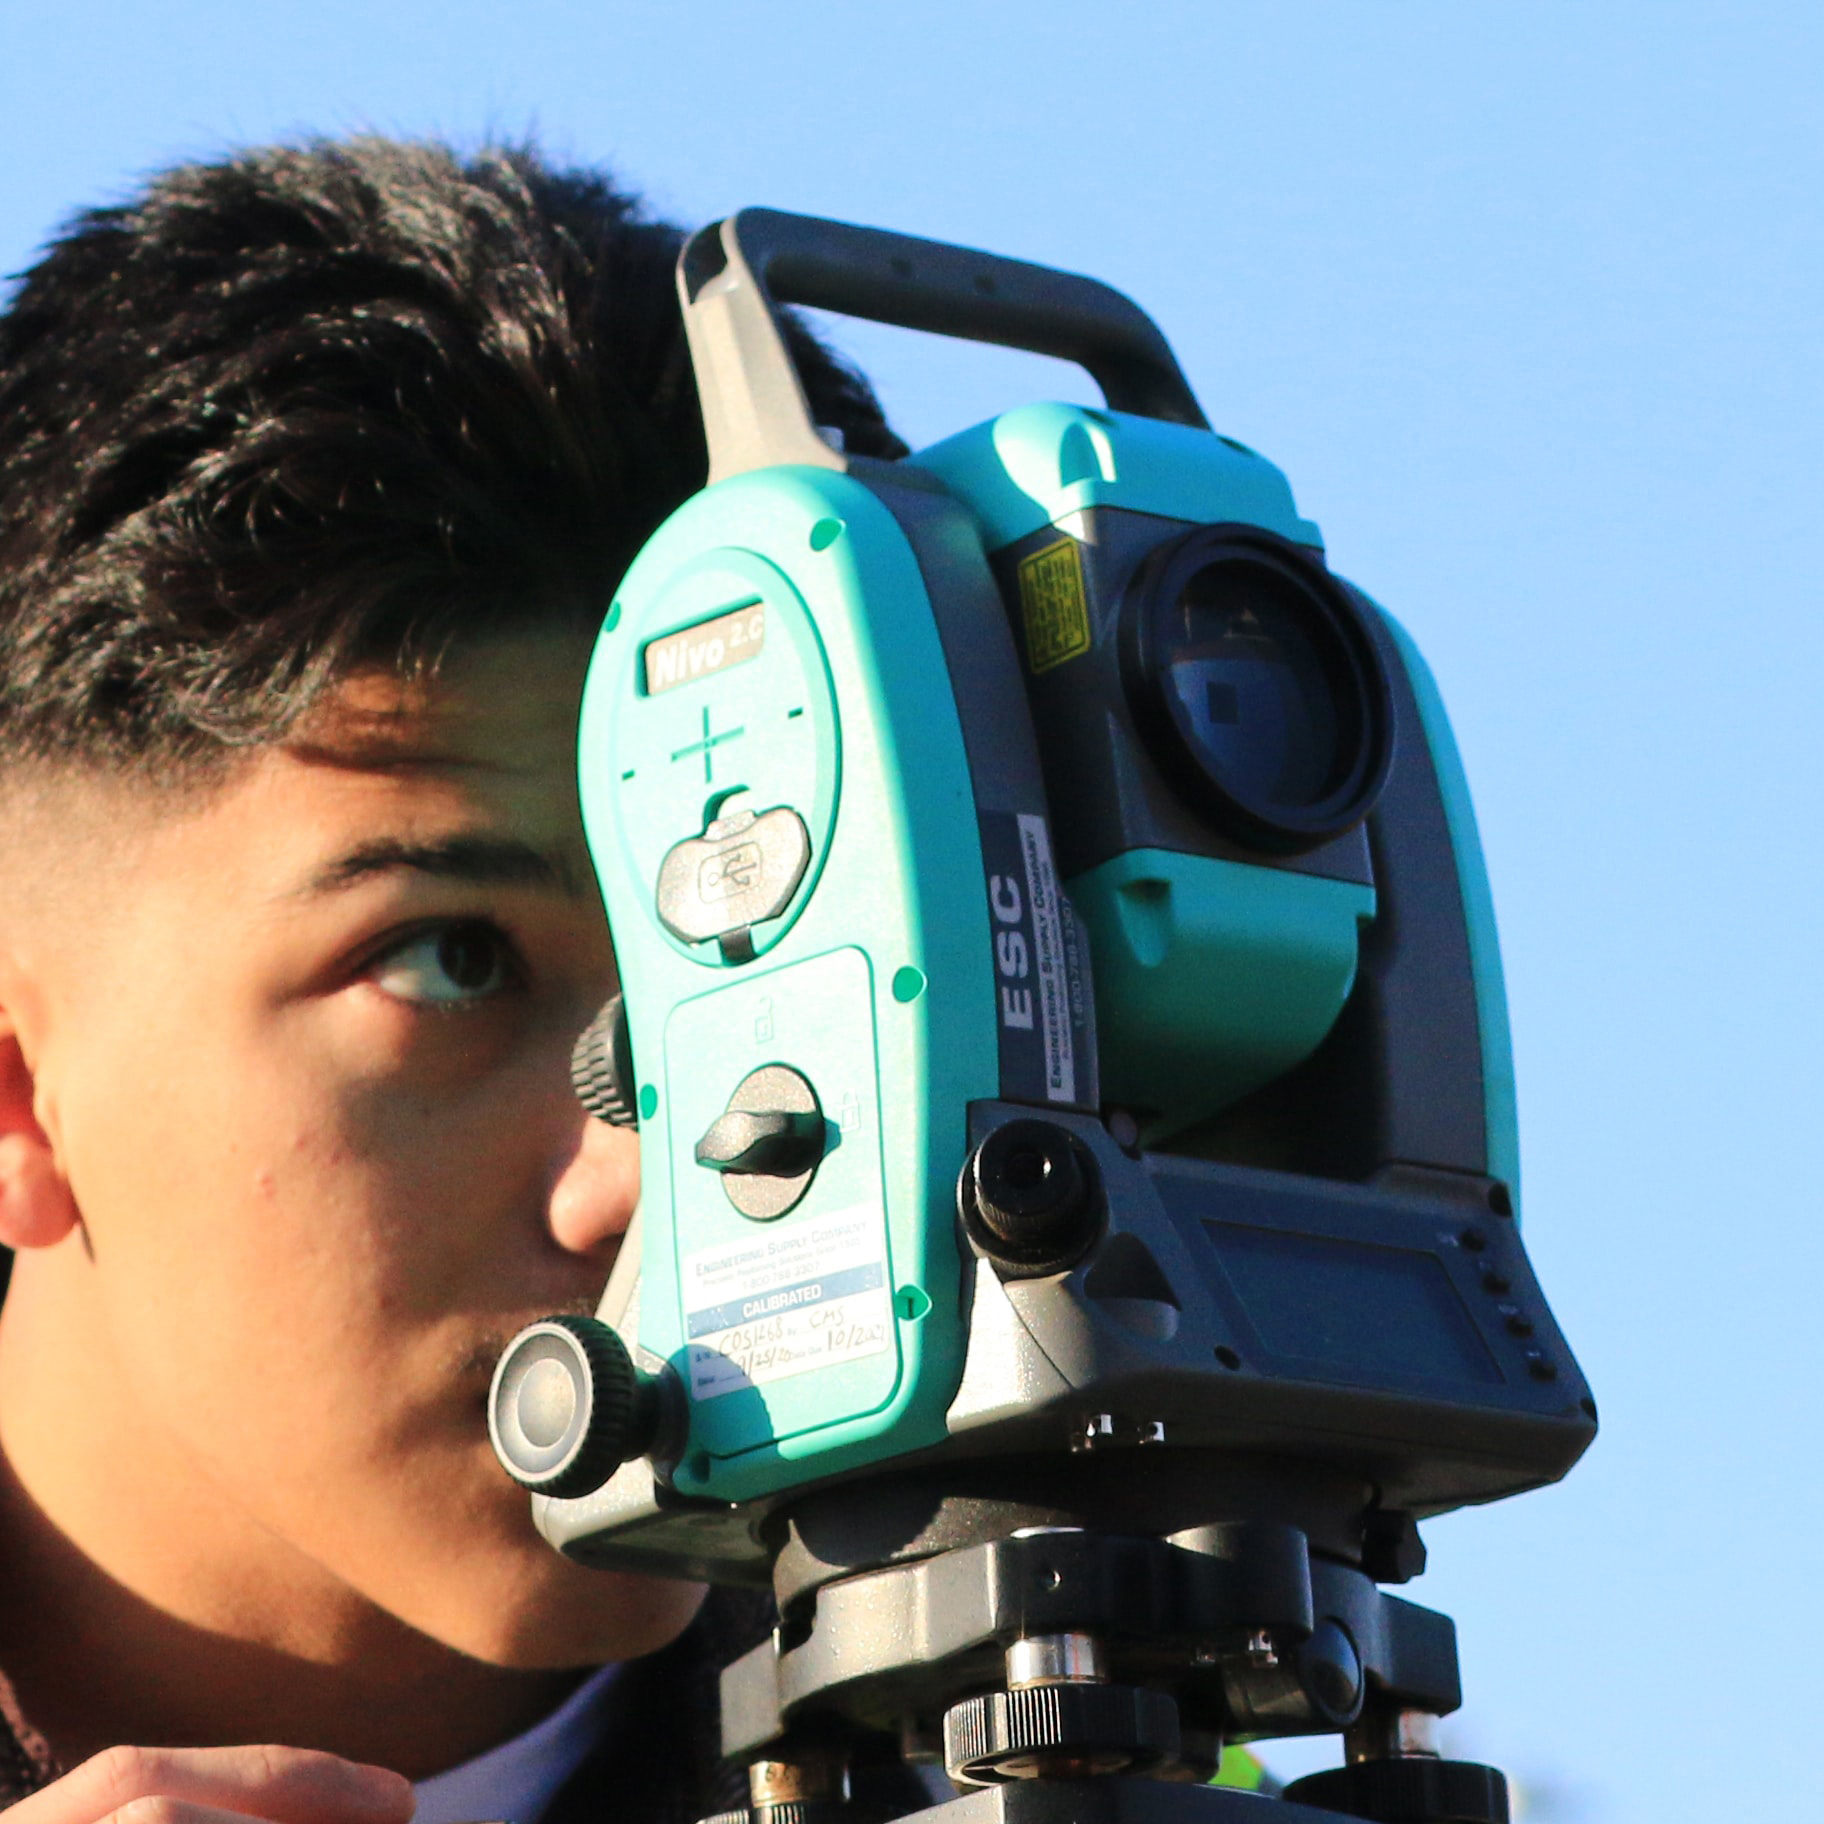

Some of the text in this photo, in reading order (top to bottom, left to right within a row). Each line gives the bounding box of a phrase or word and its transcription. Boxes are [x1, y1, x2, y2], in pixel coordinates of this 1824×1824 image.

[654, 639, 725, 686] Nivo
[990, 874, 1034, 1030] ESC
[743, 1284, 822, 1318] CALIBRATED
[809, 1306, 844, 1330] CMS
